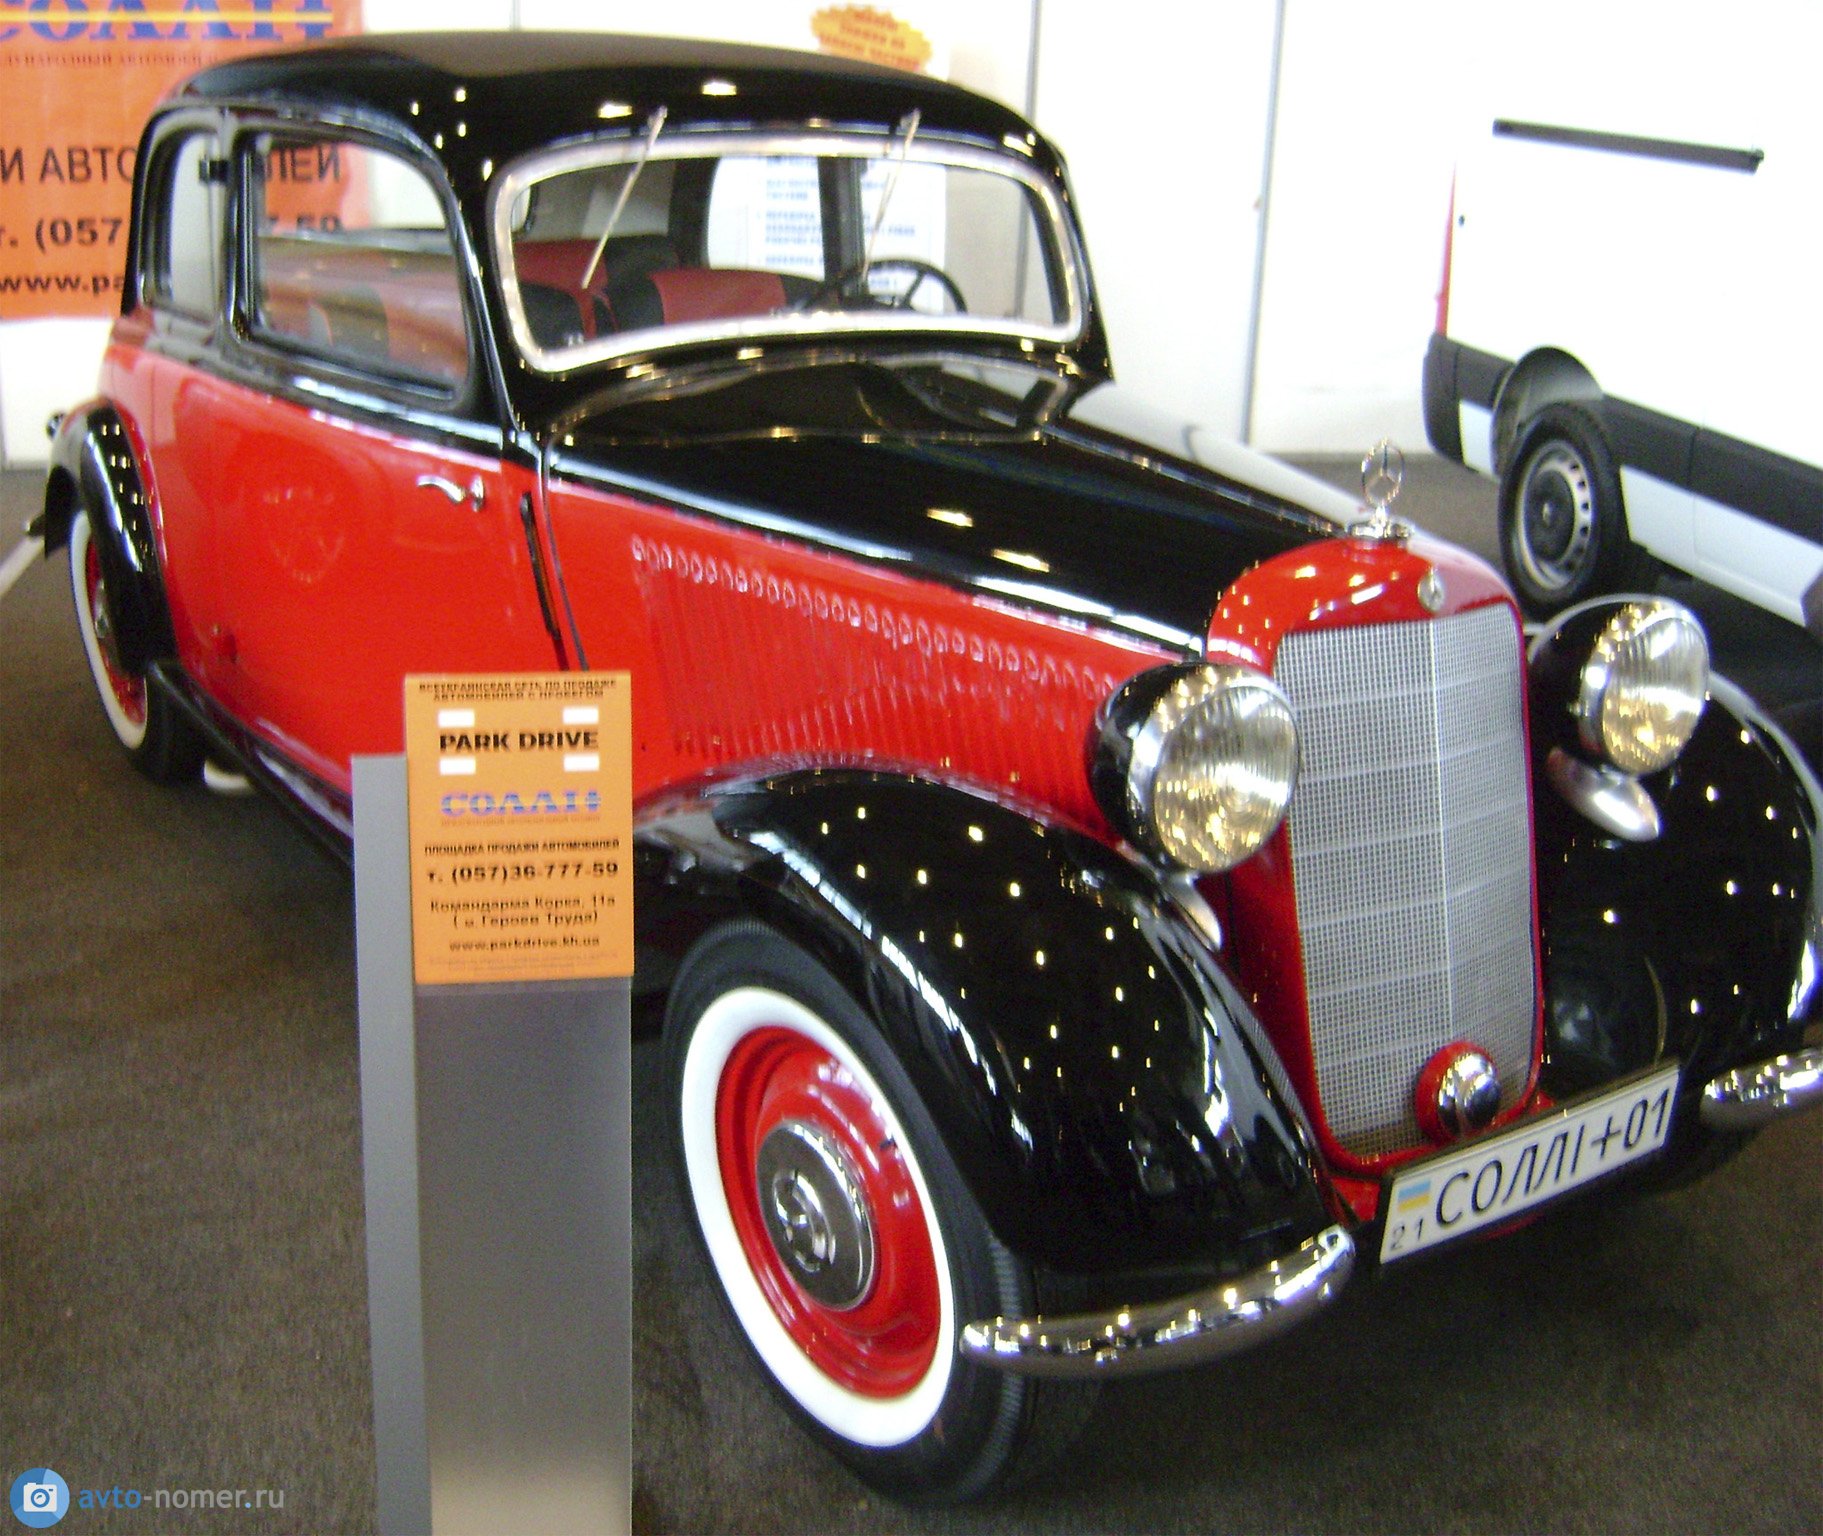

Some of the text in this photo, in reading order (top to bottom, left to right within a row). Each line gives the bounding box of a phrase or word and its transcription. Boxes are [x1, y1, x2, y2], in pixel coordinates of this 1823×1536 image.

[439, 731, 600, 751] PARK DRIVE
[430, 900, 530, 914] Командарма
[449, 936, 600, 952] www.parkdrive.kh.ua
